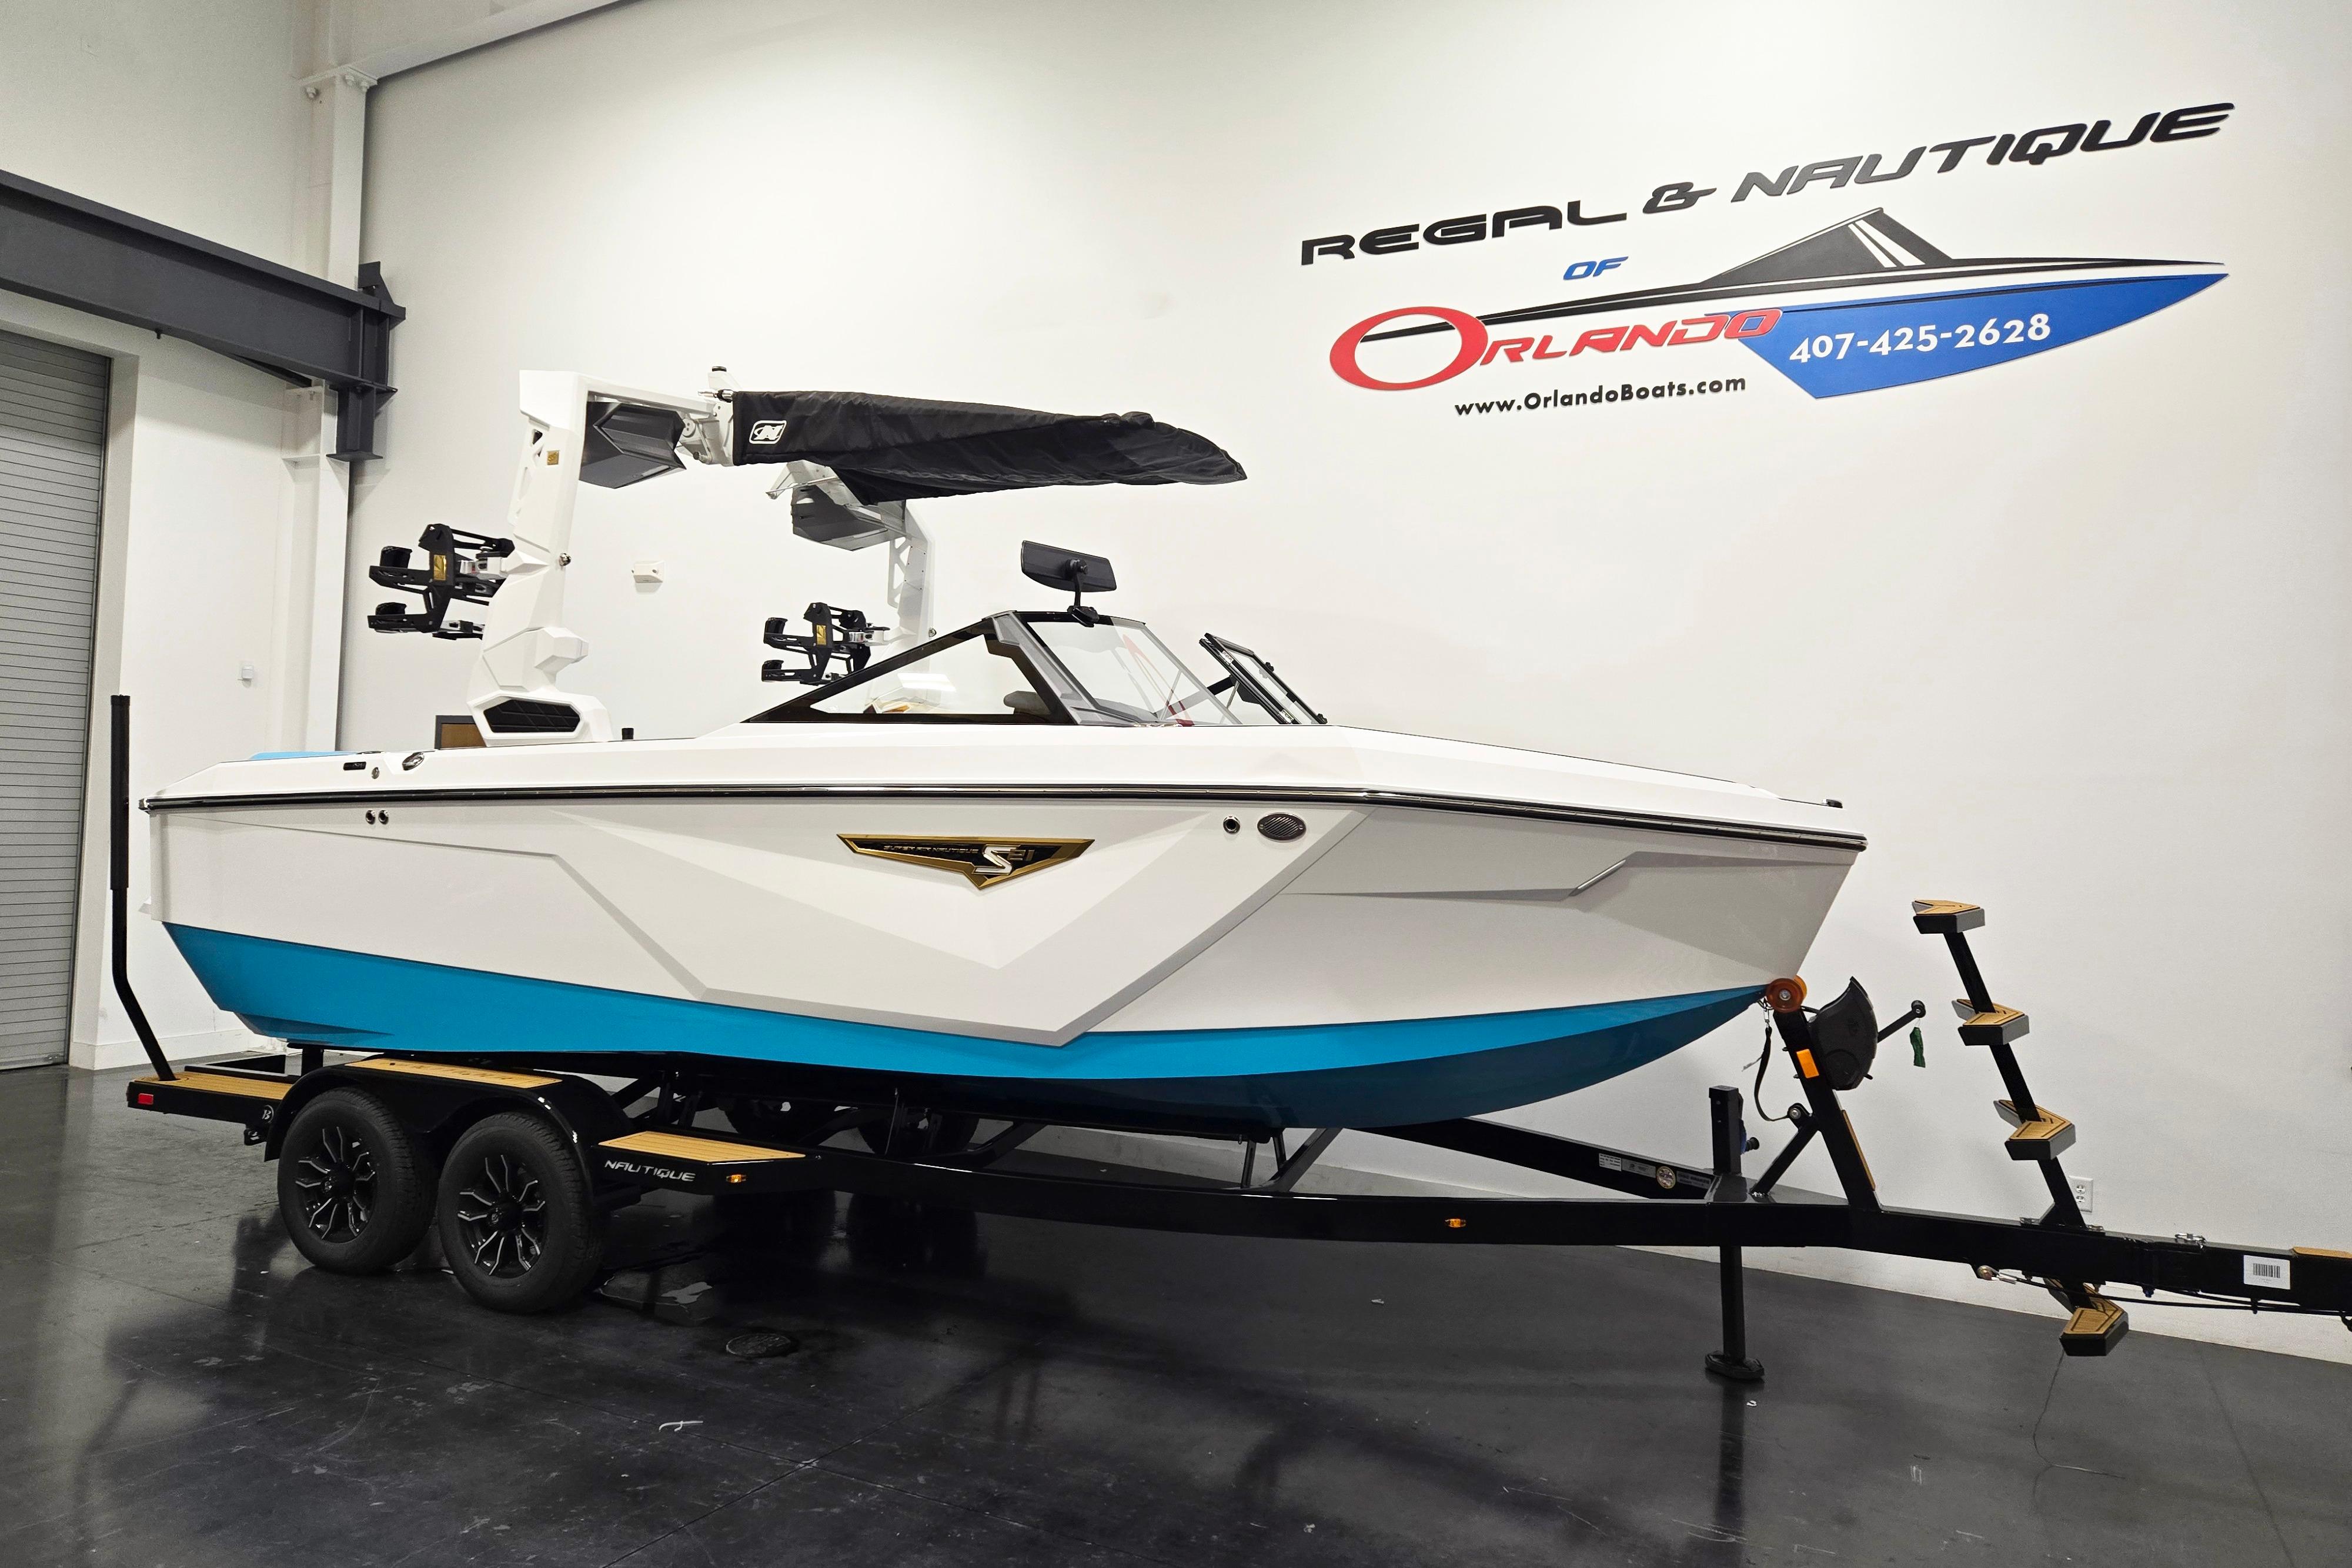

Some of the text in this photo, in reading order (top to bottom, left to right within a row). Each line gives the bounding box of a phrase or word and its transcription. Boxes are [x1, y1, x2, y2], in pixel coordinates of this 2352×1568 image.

[1301, 102, 2236, 266] REGAL & NAUTIQUE
[1563, 256, 1629, 280] OF
[1329, 306, 1782, 390] ORLANDO
[1788, 312, 2052, 364] 407-425-2628
[1455, 378, 1746, 416] www.OrlandoBoats.com
[604, 1160, 696, 1181] NAUTIQUE
